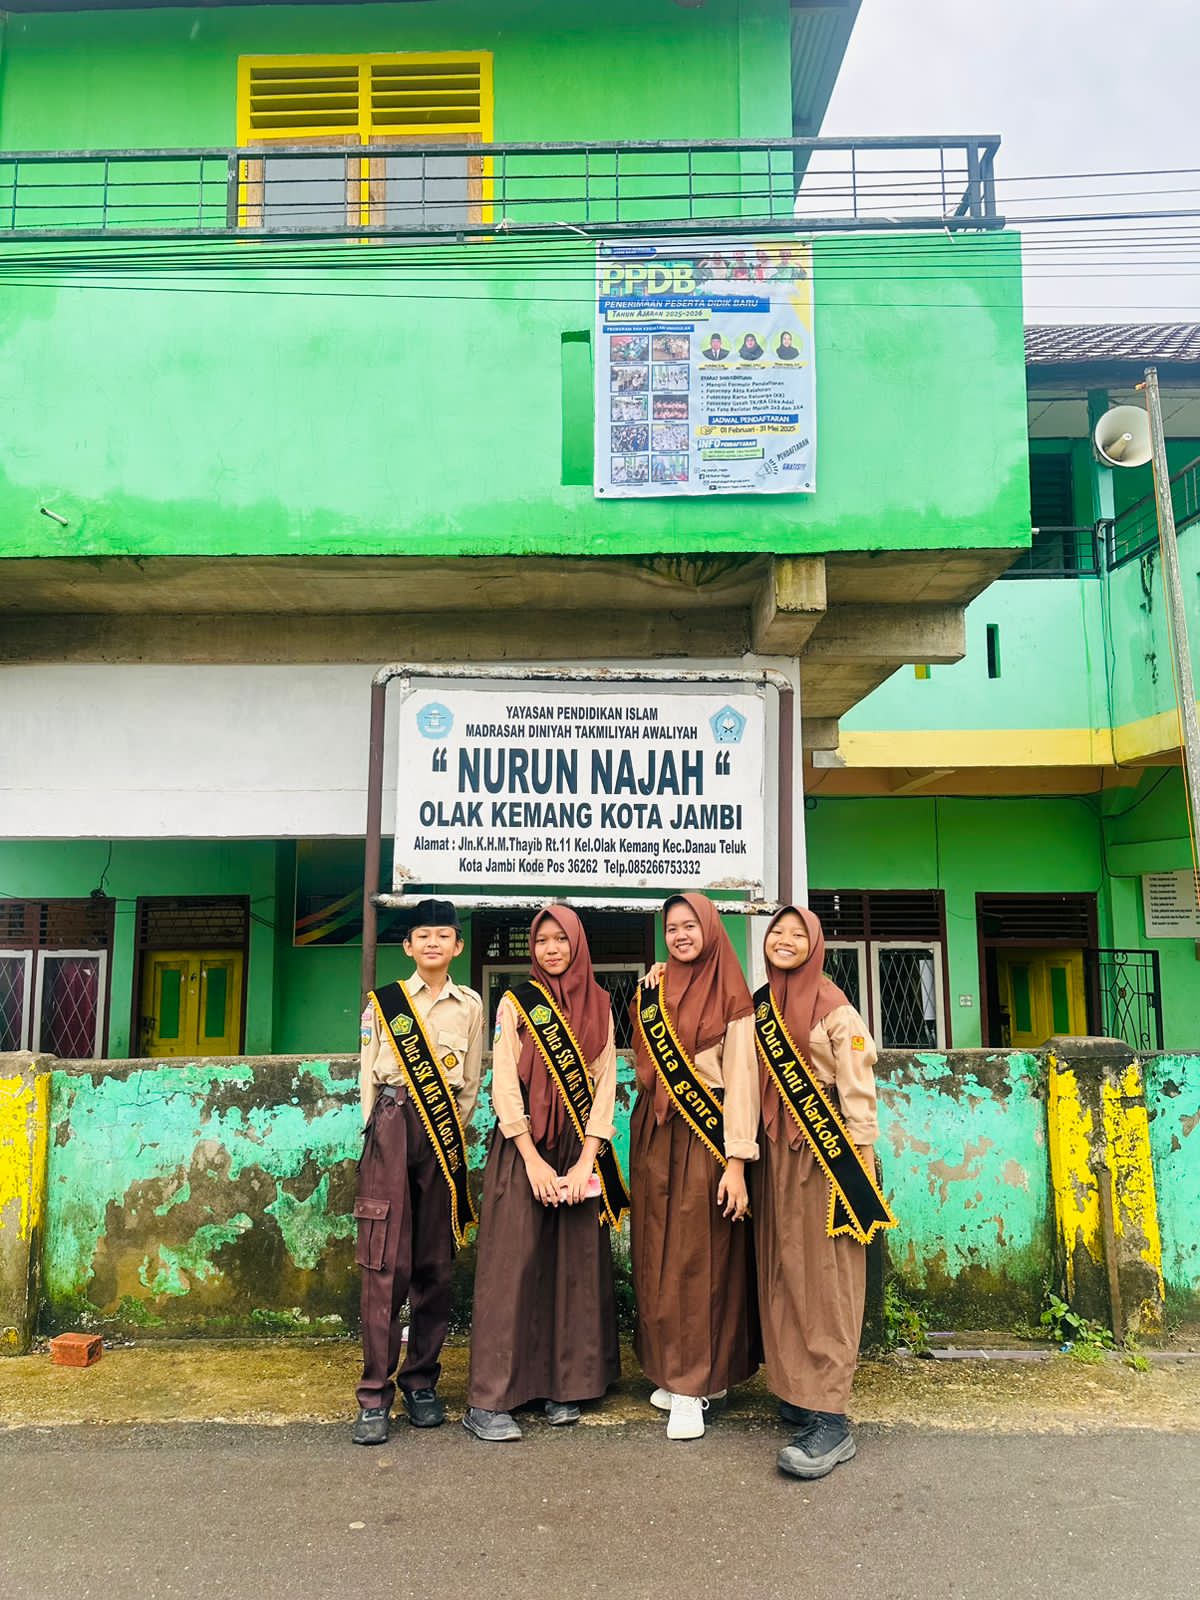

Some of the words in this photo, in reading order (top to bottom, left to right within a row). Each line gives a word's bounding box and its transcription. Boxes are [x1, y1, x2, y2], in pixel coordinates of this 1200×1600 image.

[602, 263, 696, 294] PPDB
[604, 300, 663, 308] PENERIMAAN
[665, 299, 705, 307] PESERTA
[707, 299, 731, 307] DIDIK
[733, 299, 758, 307] BARU
[711, 416, 739, 424] JADWAL
[740, 415, 790, 423] PENDAFTARAN
[698, 439, 721, 449] INFO
[777, 438, 810, 461] PENDAFTARAN
[506, 706, 554, 720] YAYASAN
[557, 706, 622, 720] PENDIDIKAN
[626, 707, 658, 721] ISLAM
[466, 724, 525, 738] MADRASAH
[529, 725, 572, 738] DINIYAH
[575, 725, 639, 739] TAKMILIYAH
[642, 726, 698, 740] AWALIYAH
[458, 748, 578, 795] NURUN
[591, 749, 704, 796] NAJAH
[419, 801, 484, 827] OLAK
[491, 801, 593, 829] KEMANG
[601, 803, 663, 829] KOTA
[670, 804, 742, 830] JAMBI
[414, 836, 449, 851] Alamat
[458, 836, 542, 855] Jln.K.H.M.Thayib
[545, 837, 571, 852] Rt.11
[575, 838, 616, 853] Kel.Olak
[620, 839, 660, 857] Kemang
[662, 839, 716, 853] Kec.Danau
[719, 840, 747, 854] Teluk
[459, 858, 482, 872] Kota
[485, 858, 516, 873] Jambi
[518, 858, 544, 873] Kode
[546, 859, 565, 873] Pos
[568, 859, 598, 873] 36262
[604, 859, 701, 877] Telp.085266753332
[401, 1034, 420, 1062] Duta
[542, 1023, 562, 1050] Duta
[412, 1060, 434, 1083] SSK
[555, 1049, 575, 1071] SSK
[564, 1068, 582, 1092] MTs
[650, 1021, 679, 1072] Duta
[673, 1080, 718, 1129] genre
[422, 1081, 442, 1104] MTs
[572, 1088, 585, 1102] N
[761, 1020, 783, 1059] Duta
[779, 1060, 807, 1093] Anti
[799, 1093, 842, 1159] Narkoba
[431, 1101, 448, 1115] N
[437, 1118, 454, 1146] Kota
